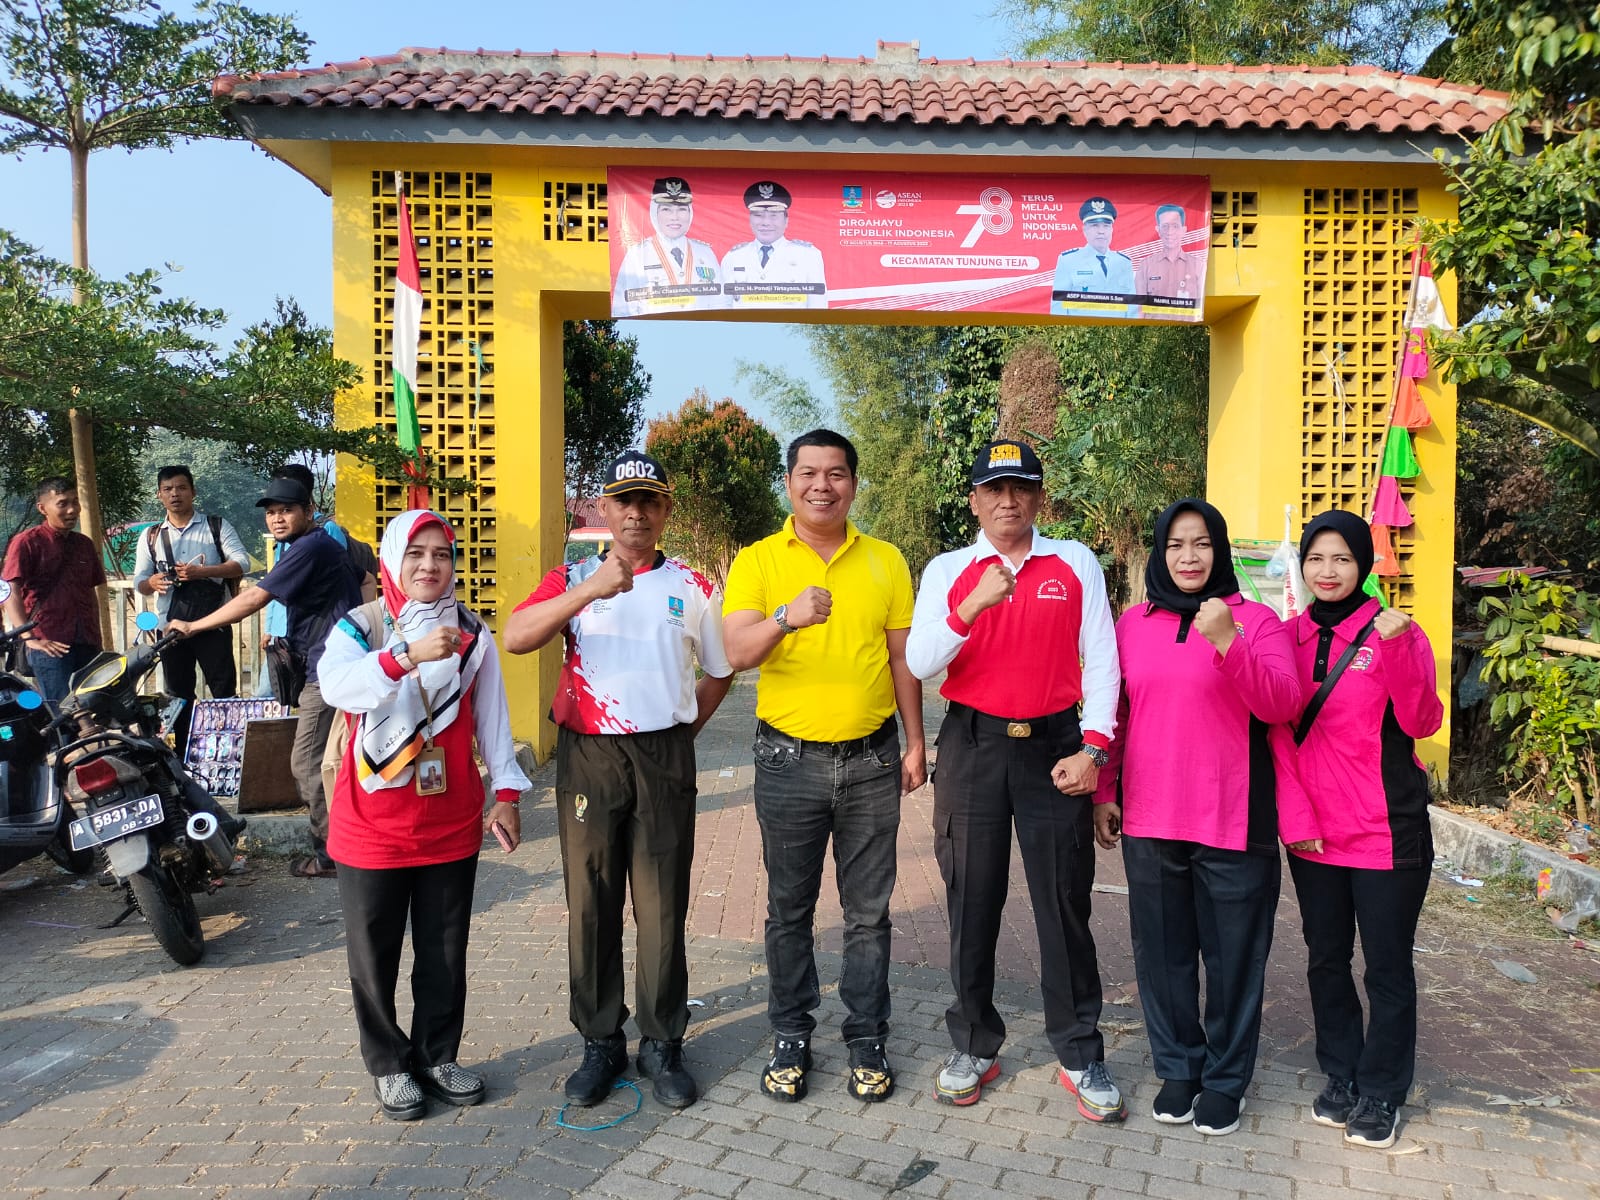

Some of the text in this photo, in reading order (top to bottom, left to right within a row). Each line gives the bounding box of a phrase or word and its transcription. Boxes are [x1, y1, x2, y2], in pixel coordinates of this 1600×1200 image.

[1021, 194, 1055, 202] TERUS
[1021, 203, 1063, 211] MELAJU
[955, 187, 1014, 249] 78
[1022, 213, 1057, 221] UNTUK
[839, 219, 903, 227] DIRGAHAYU
[1022, 222, 1078, 231] INDONESIA
[839, 229, 956, 239] REPUBLIK INDONESIA
[1023, 232, 1052, 240] MAJU
[891, 256, 1028, 267] KECAMATAN TUNJUNG TEJA
[615, 460, 658, 481] 0602
[72, 822, 85, 837] A
[93, 807, 128, 828] 5831
